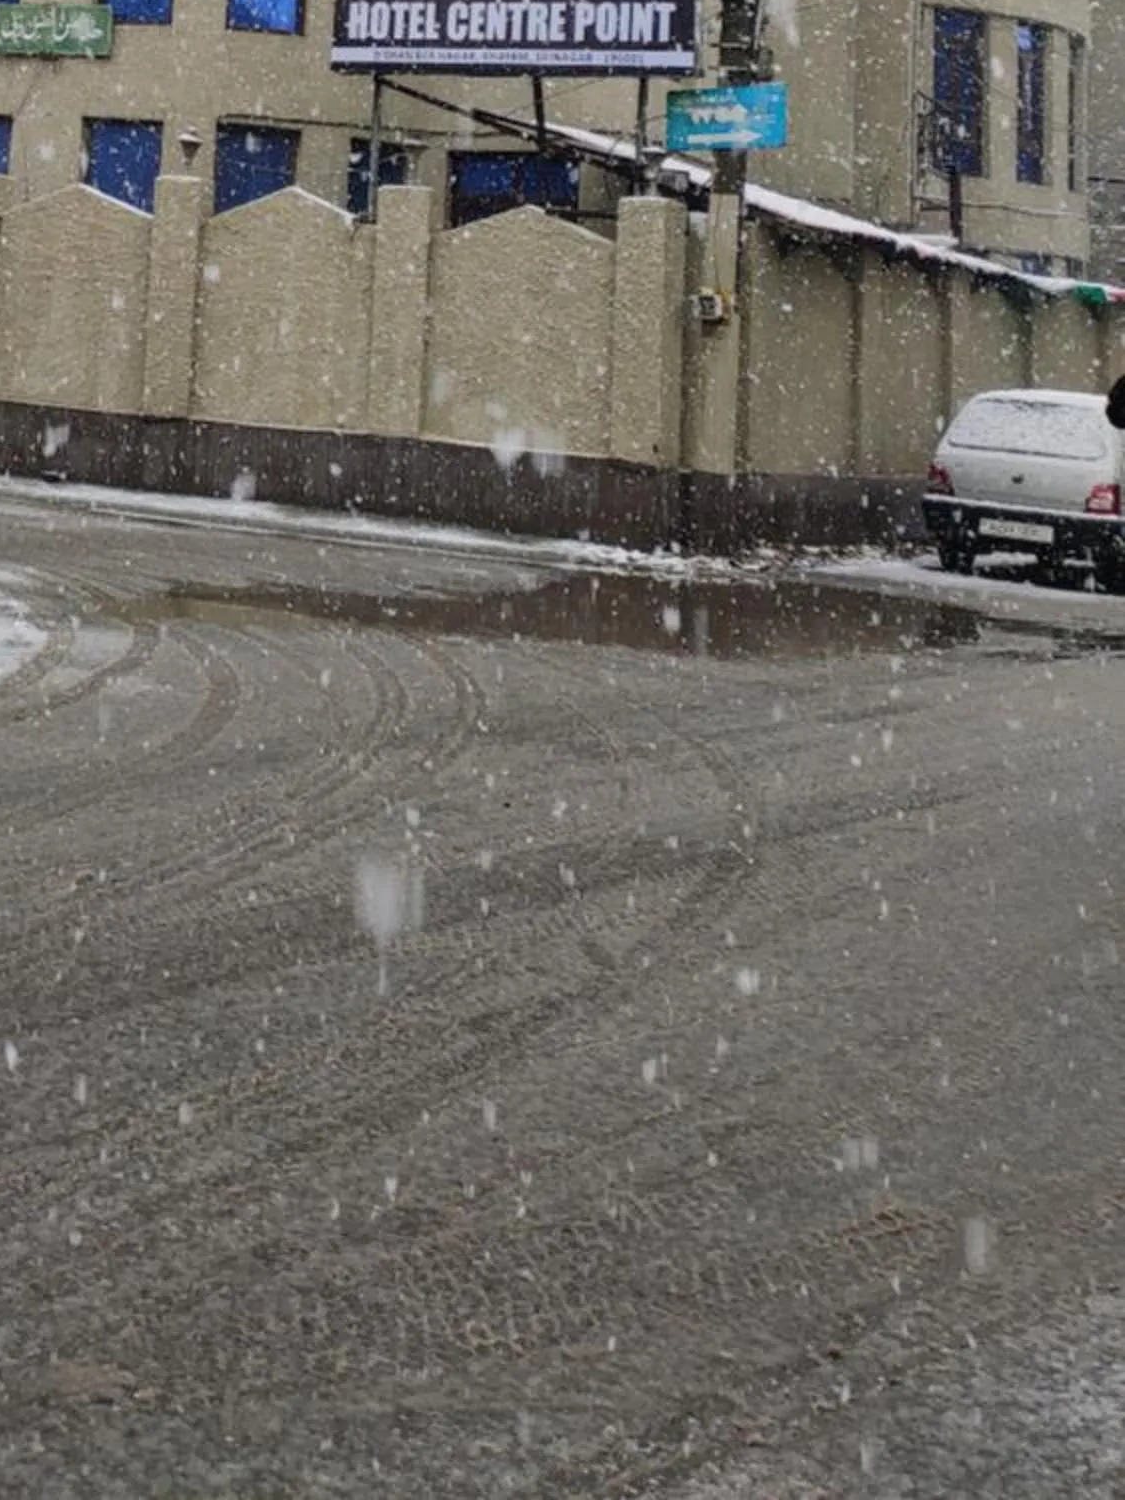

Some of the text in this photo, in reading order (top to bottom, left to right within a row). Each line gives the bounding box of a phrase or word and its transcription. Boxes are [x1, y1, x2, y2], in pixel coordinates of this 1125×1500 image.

[348, 1, 677, 43] HOTEL CENTRE POINT
